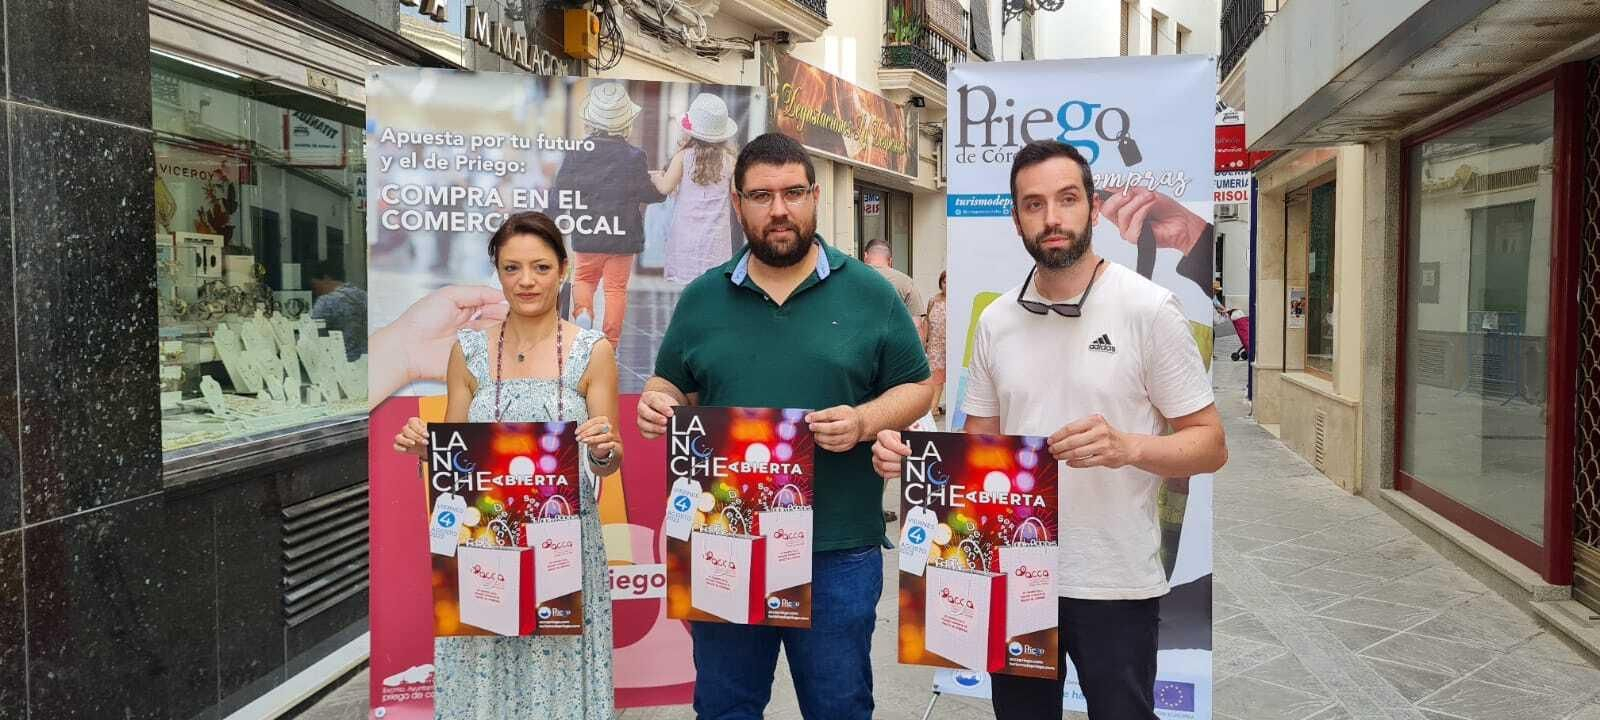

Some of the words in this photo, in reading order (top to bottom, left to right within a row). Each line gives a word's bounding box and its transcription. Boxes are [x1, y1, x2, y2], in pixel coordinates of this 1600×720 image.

[955, 83, 1130, 166] Priego
[380, 127, 465, 147] Apuesta
[471, 135, 504, 151] por
[512, 134, 531, 150] tu
[537, 133, 595, 151] futuro
[381, 155, 393, 171] y
[399, 152, 417, 169] el
[424, 153, 448, 170] de
[456, 154, 526, 176] Priego:
[956, 144, 976, 164] de
[159, 163, 214, 180] VICEROY
[1093, 168, 1192, 196] ompras
[381, 184, 504, 207] COMPRA
[512, 188, 549, 209] EN
[558, 189, 588, 210] EL
[955, 195, 1013, 209] turismodep
[381, 209, 509, 233] COMERC
[554, 214, 627, 236] OCAL
[1089, 344, 1115, 353] adidas
[671, 415, 706, 437] LA
[431, 430, 468, 451] LA
[906, 439, 942, 462] LA
[670, 456, 729, 478] CHE
[729, 462, 803, 475] ABIERTA
[431, 471, 492, 492] CHE
[491, 474, 569, 487] ABIERTA
[675, 496, 688, 510] 4
[905, 482, 966, 508] CHE
[966, 490, 1046, 508] ABIERTA
[439, 512, 453, 527] 4
[909, 527, 922, 543] 4
[609, 569, 666, 595] iego
